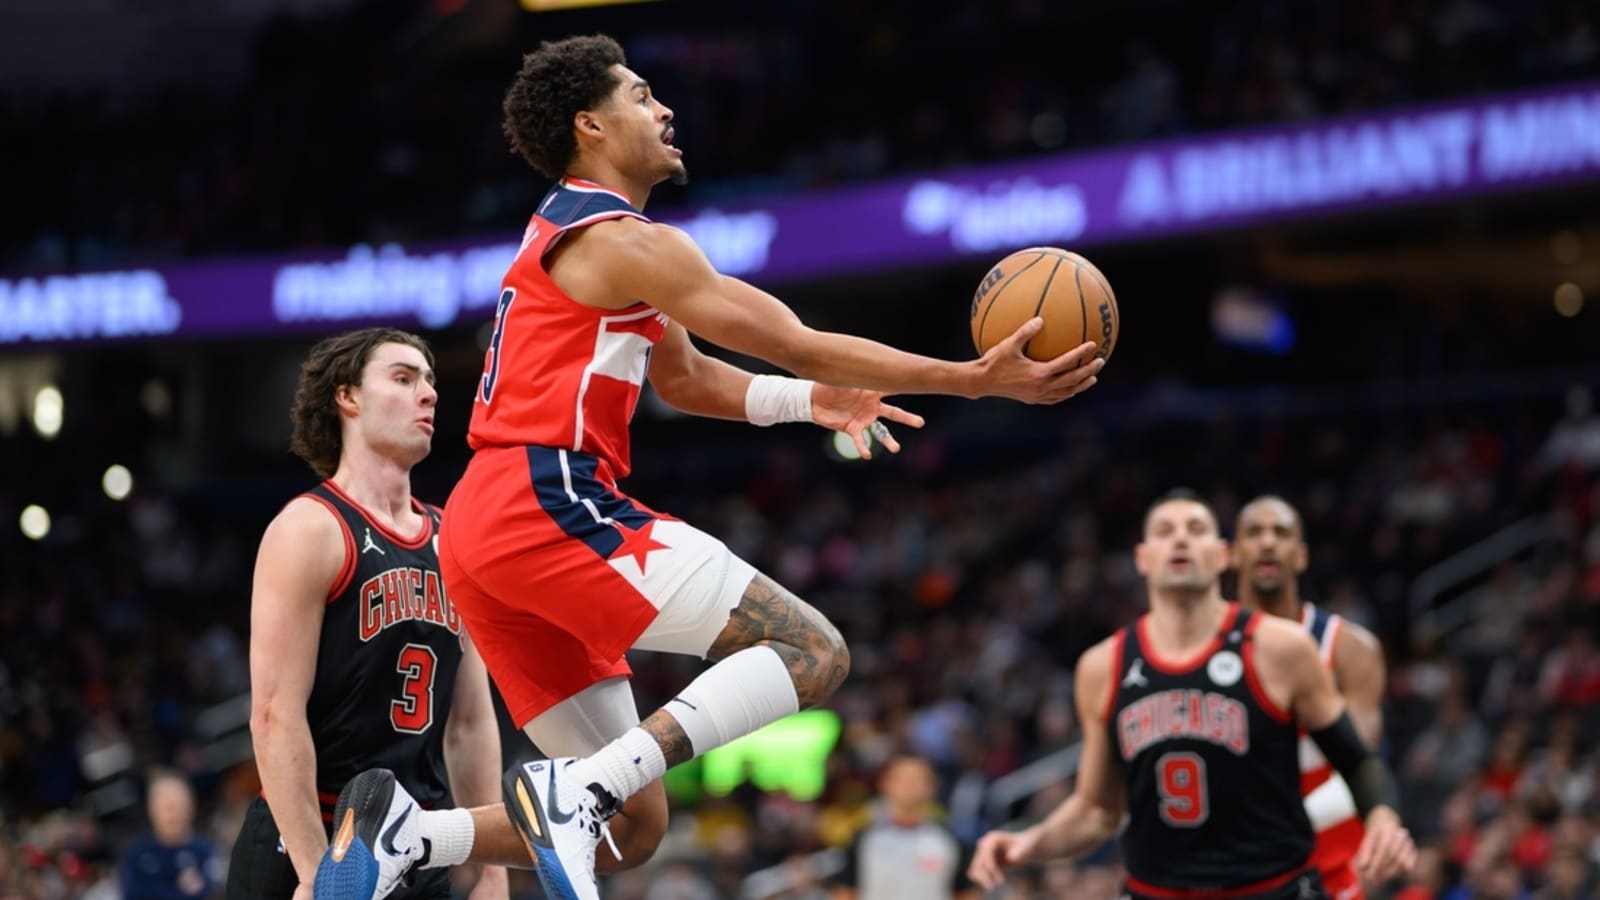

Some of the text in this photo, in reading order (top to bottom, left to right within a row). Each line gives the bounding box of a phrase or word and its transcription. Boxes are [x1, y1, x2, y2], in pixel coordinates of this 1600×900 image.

[1173, 108, 1471, 222] BRILLIANT
[360, 567, 467, 653] CHICAG
[390, 643, 438, 735] 3
[1117, 688, 1249, 761] CHICAGO
[1155, 751, 1210, 829] 9
